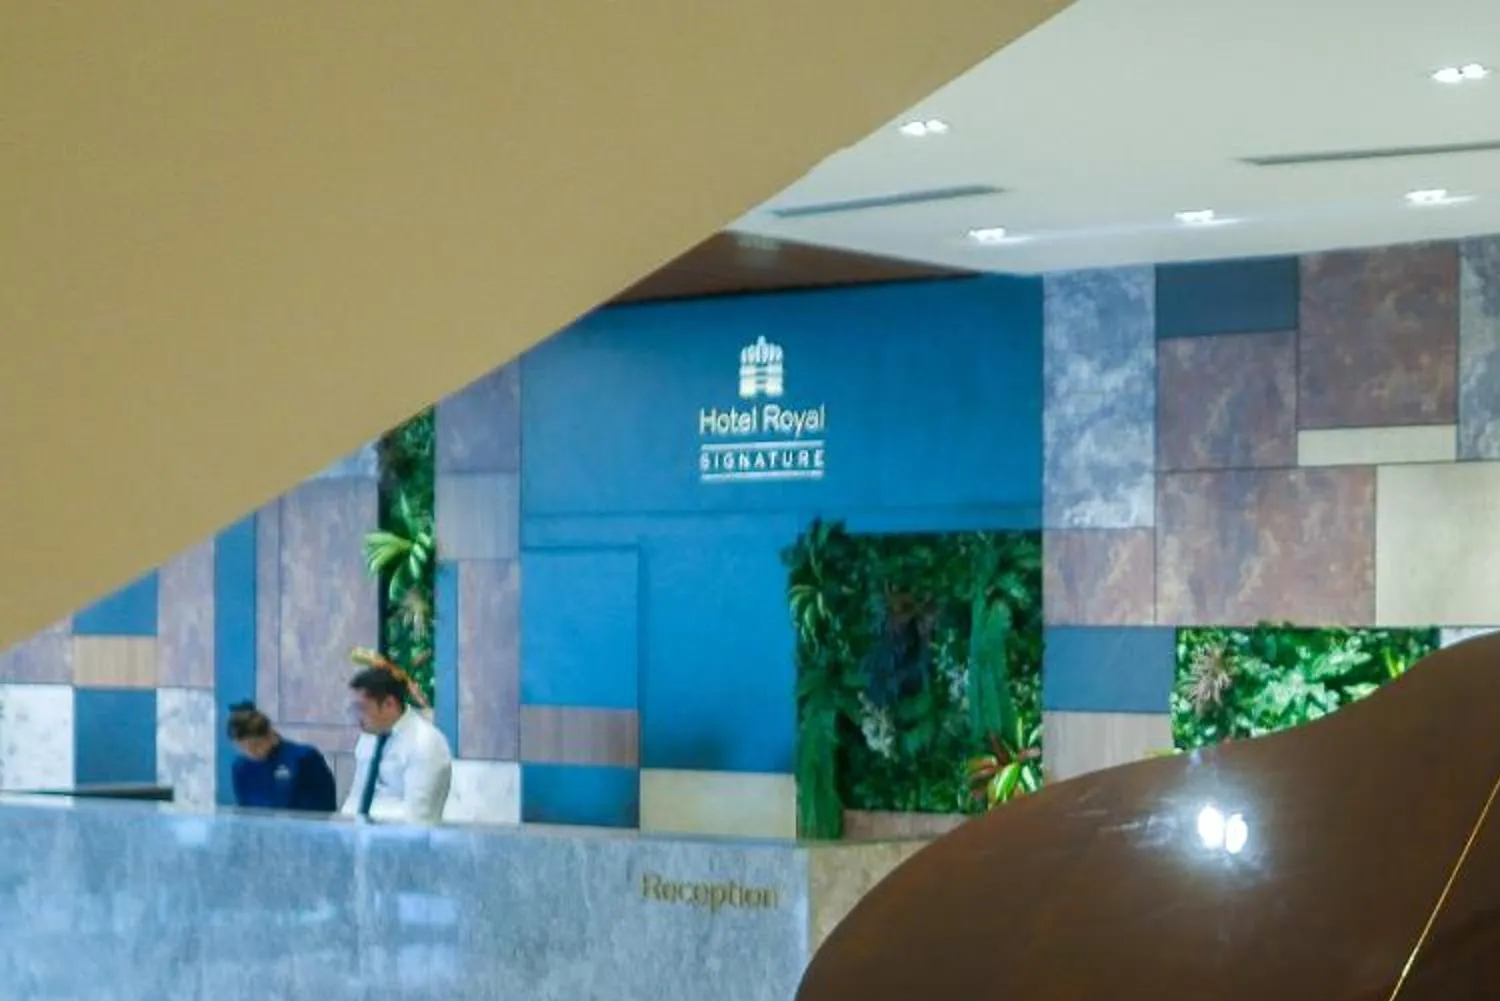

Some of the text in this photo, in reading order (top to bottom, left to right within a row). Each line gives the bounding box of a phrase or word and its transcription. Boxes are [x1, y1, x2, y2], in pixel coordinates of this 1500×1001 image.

[700, 403, 825, 437] Hotel Royal
[700, 449, 824, 470] SIGNATURE
[641, 871, 778, 914] Reception
